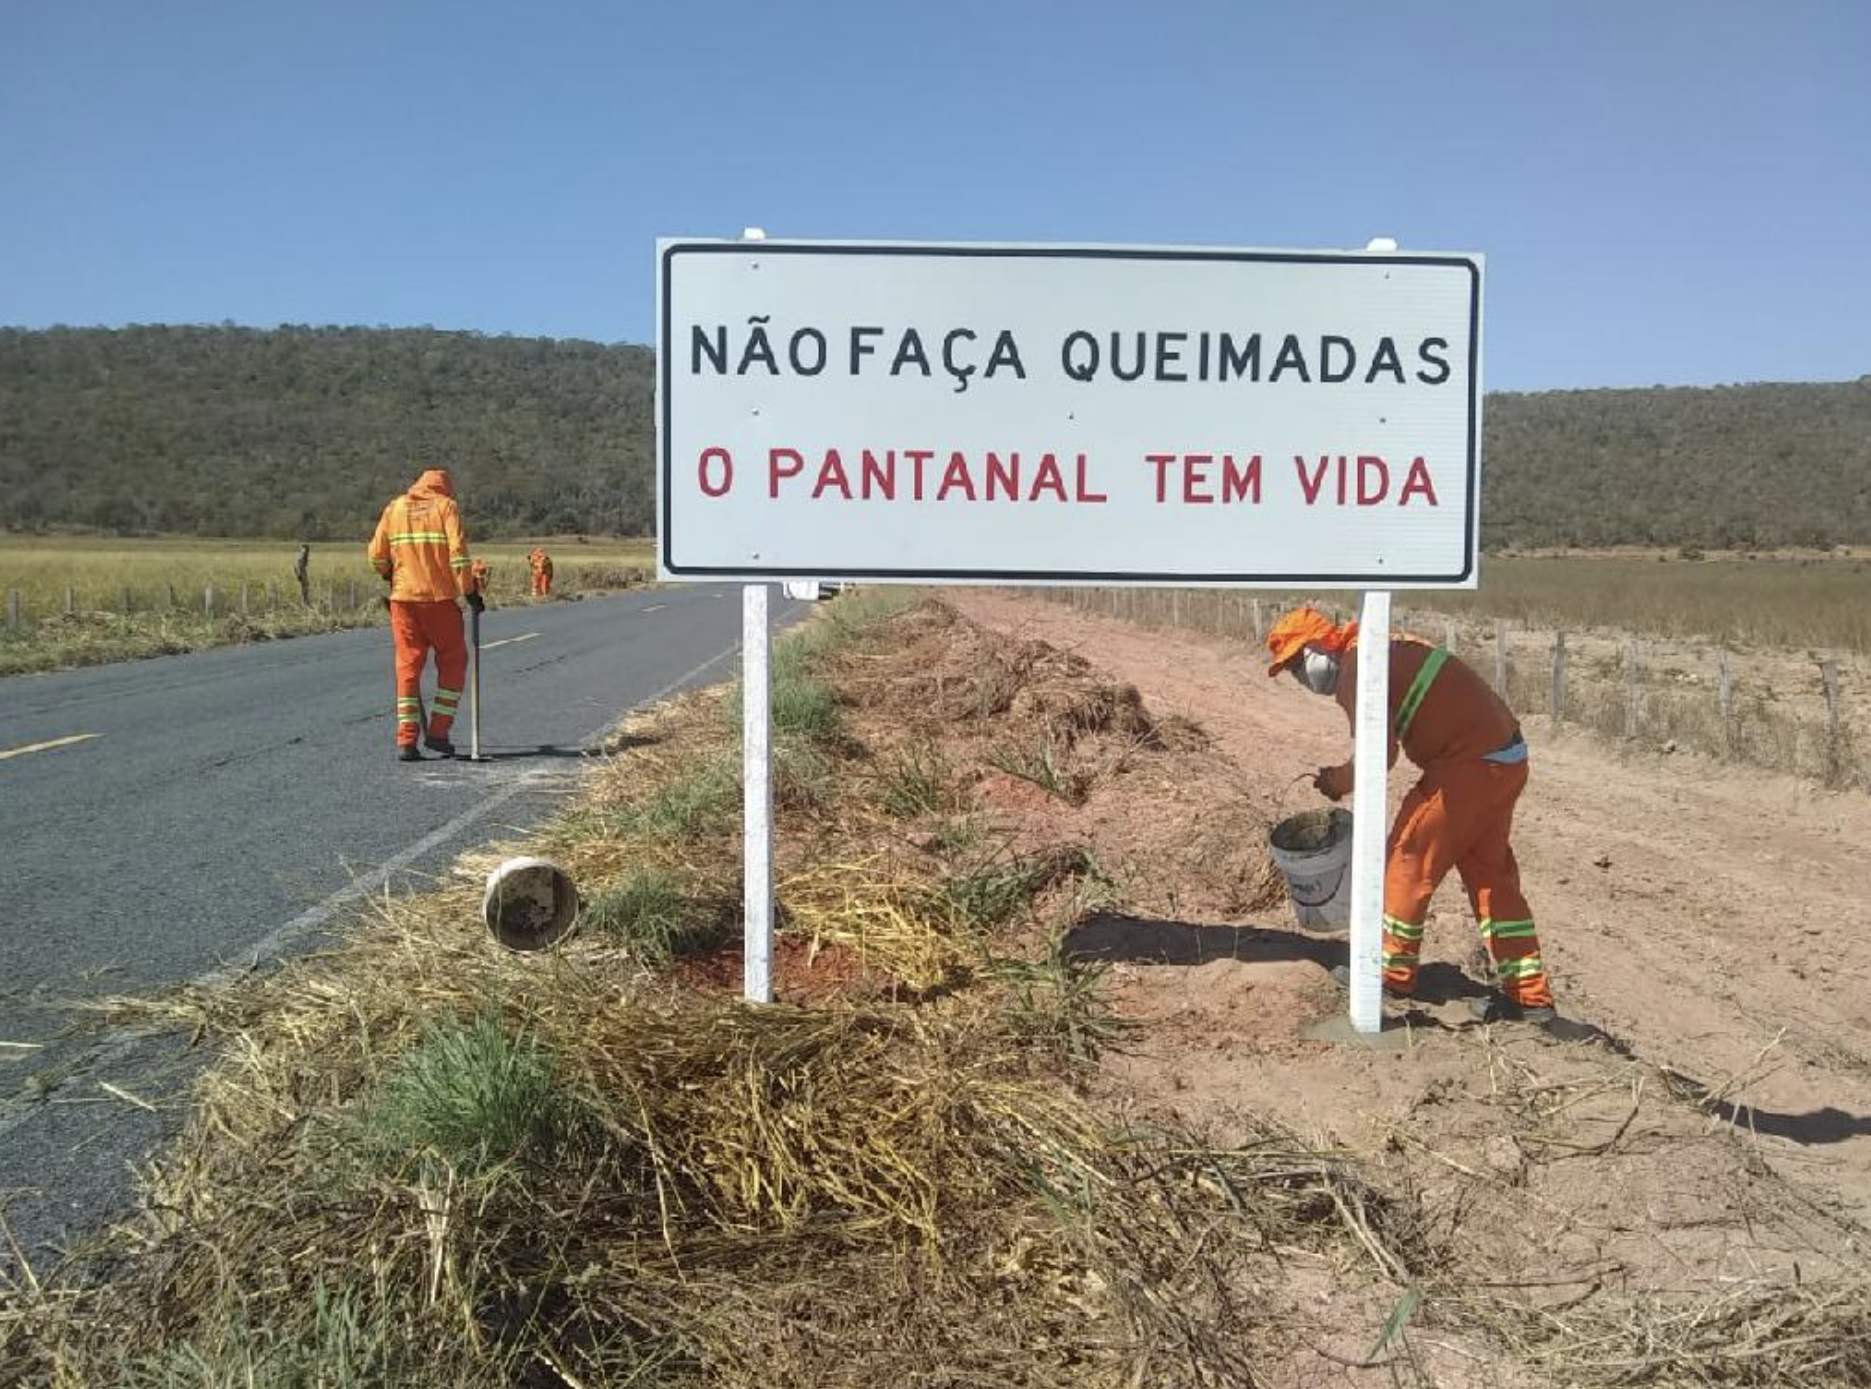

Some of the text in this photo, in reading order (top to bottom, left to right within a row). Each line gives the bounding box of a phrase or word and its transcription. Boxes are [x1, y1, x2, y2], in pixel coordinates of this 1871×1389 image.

[692, 315, 1450, 393] NÃO FAÇA QUEIMADAS
[699, 448, 1437, 506] O PANTANAL TEM VIDA
